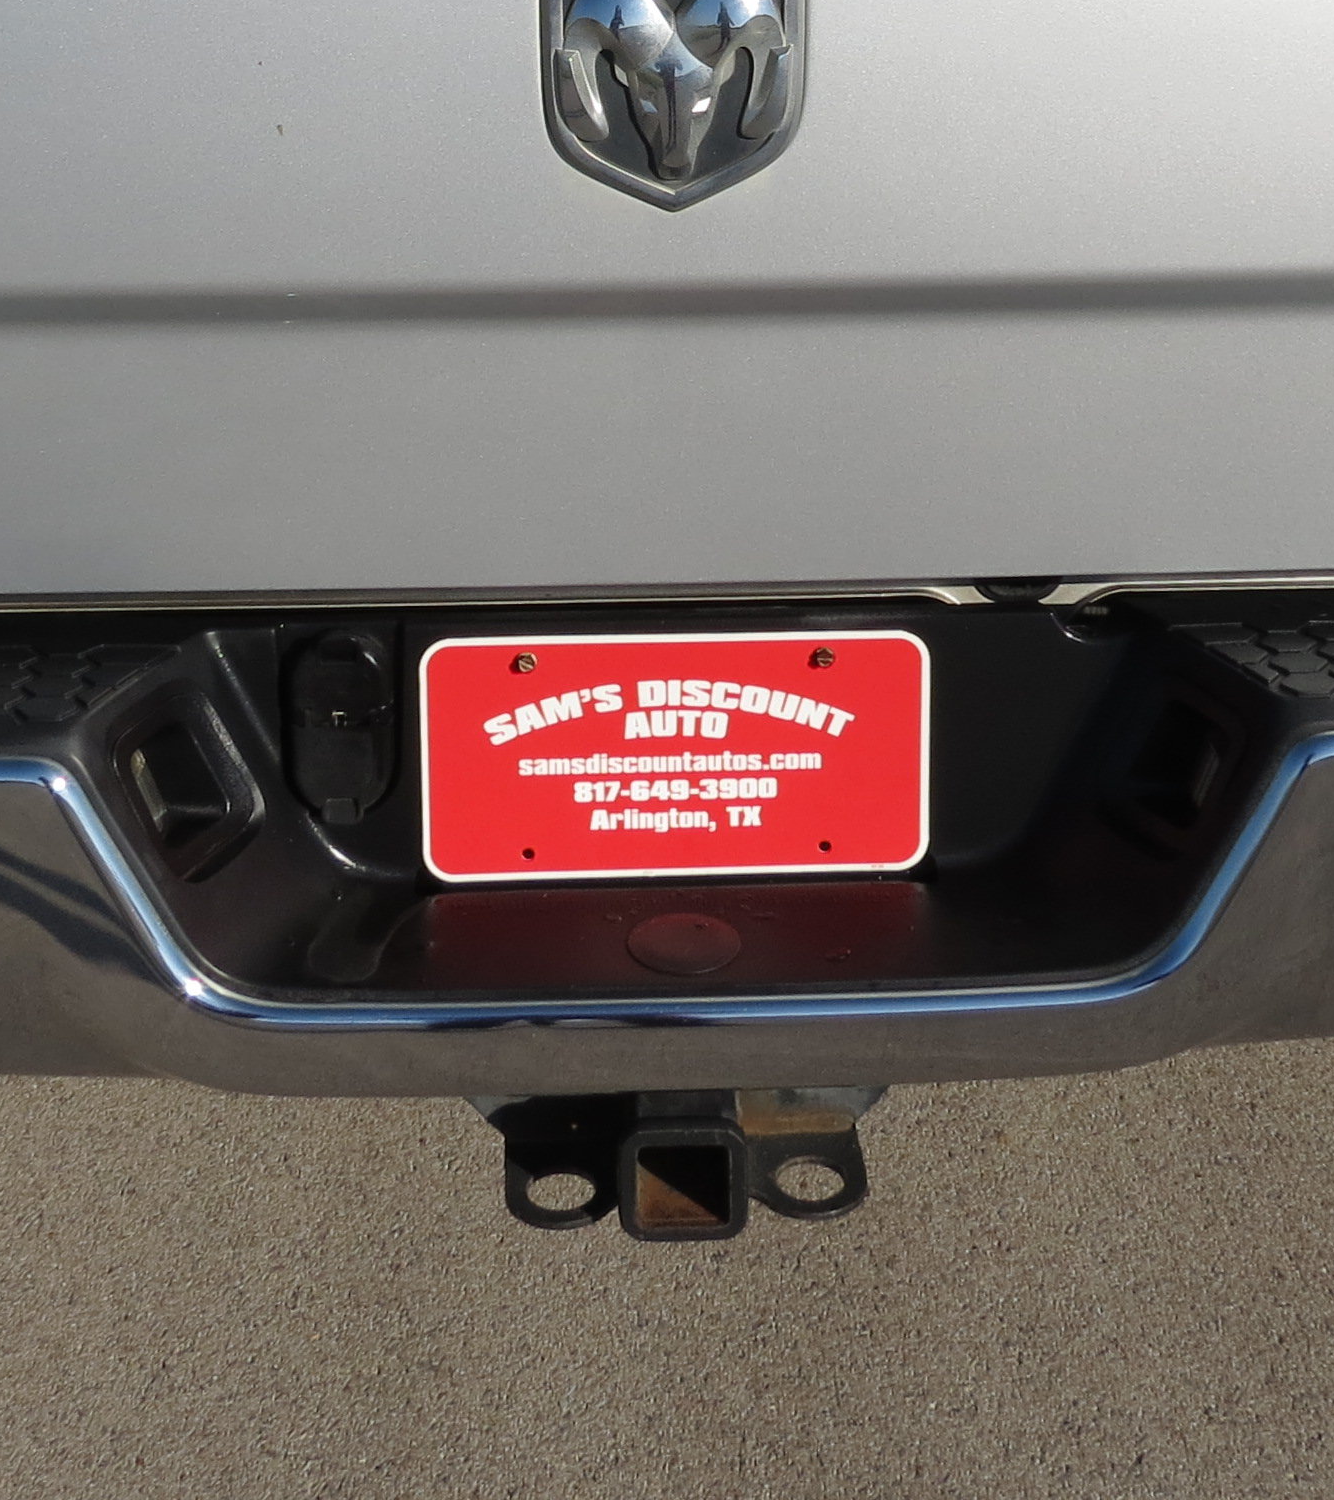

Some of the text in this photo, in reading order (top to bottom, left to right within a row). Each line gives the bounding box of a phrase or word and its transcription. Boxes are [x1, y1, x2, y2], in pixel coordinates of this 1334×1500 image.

[483, 679, 855, 746] SAM'S DISCOUNT
[624, 709, 729, 740] AUTO
[518, 751, 822, 776] samsdiscountautos.com
[573, 777, 778, 803] 817-649-3900
[590, 806, 762, 833] Arlington, TX
